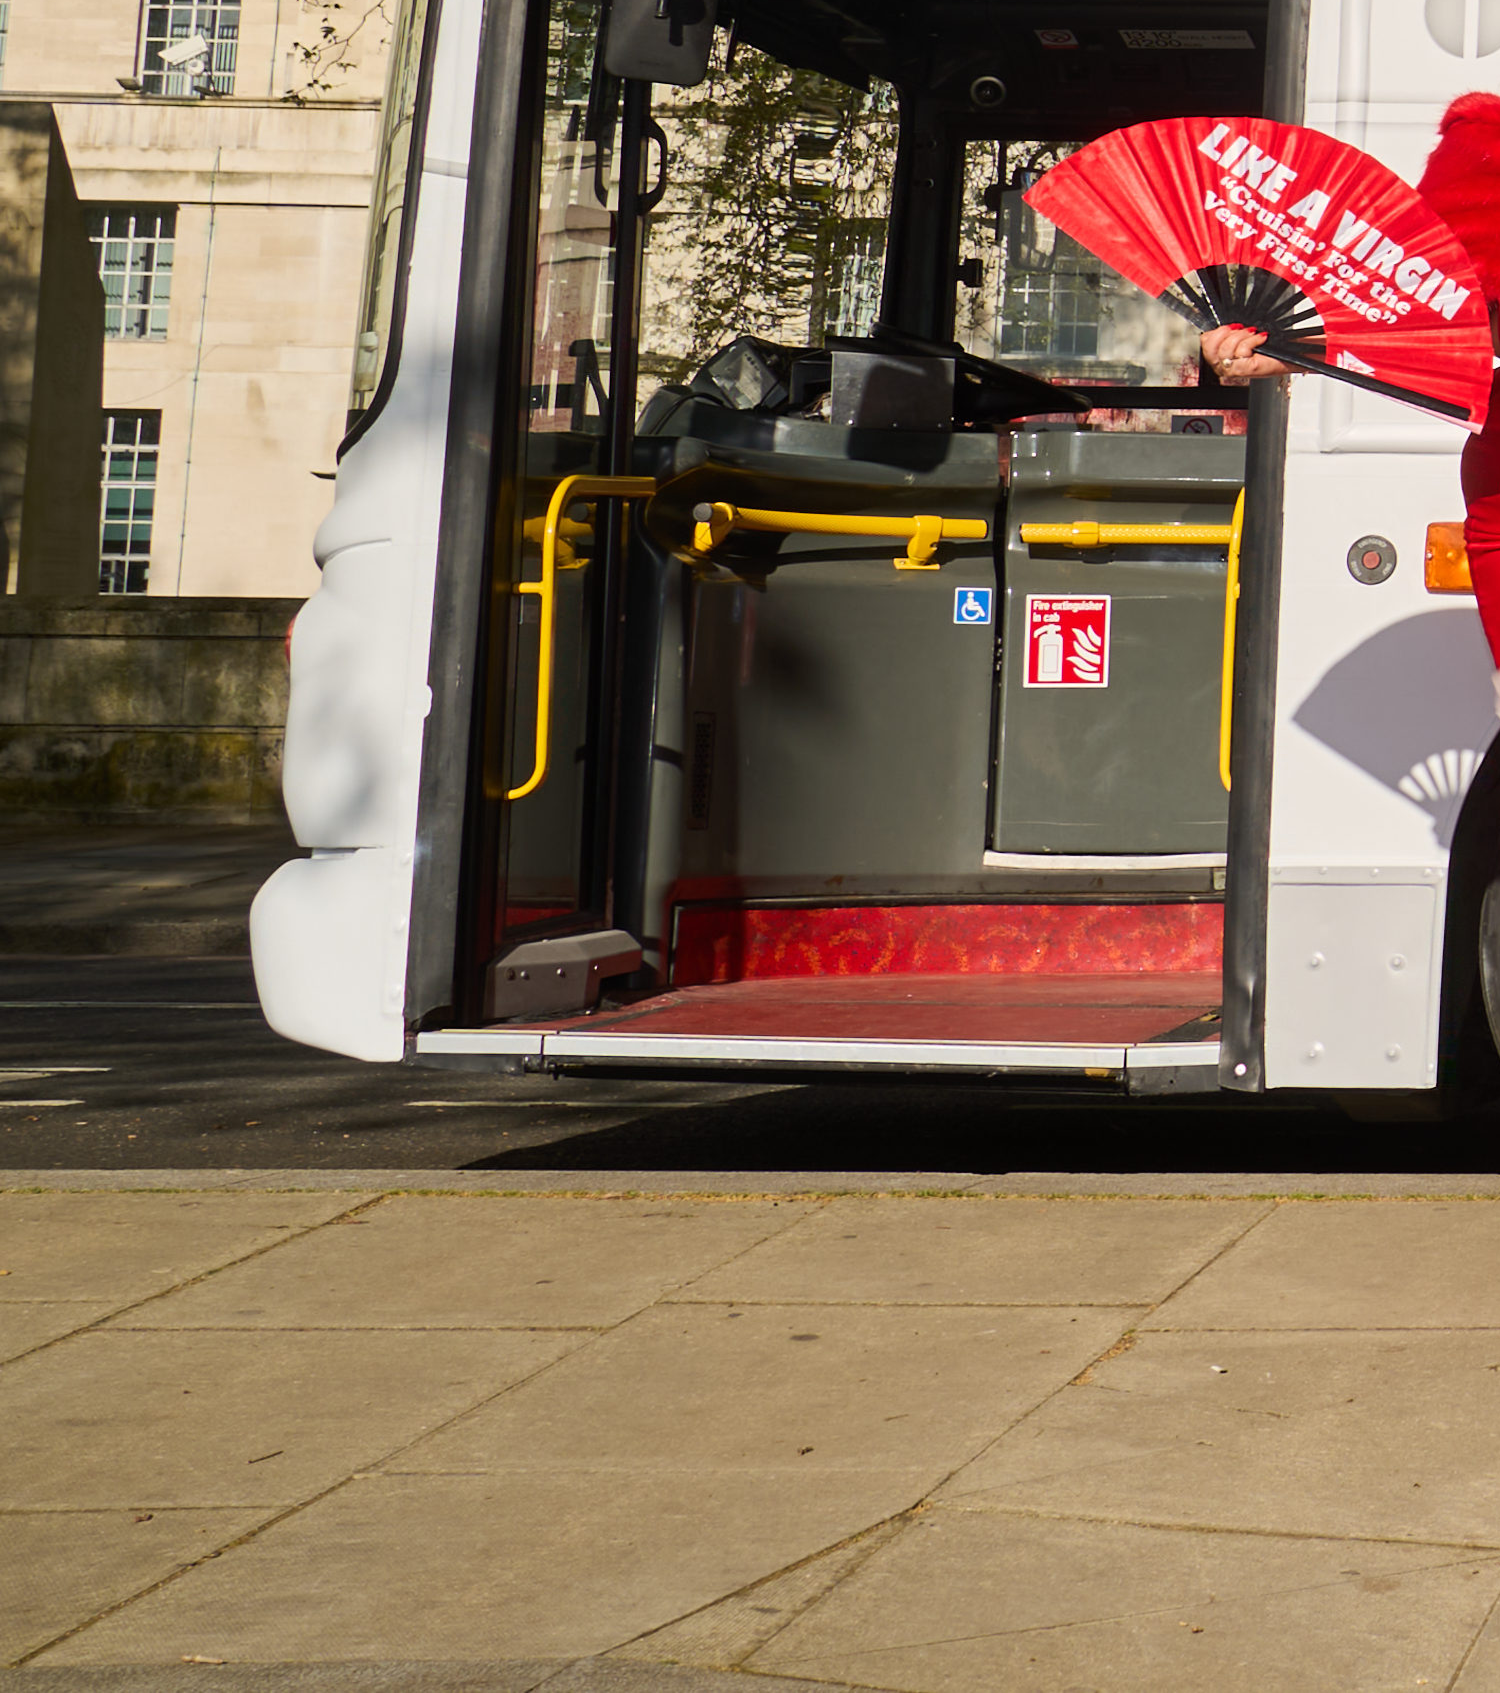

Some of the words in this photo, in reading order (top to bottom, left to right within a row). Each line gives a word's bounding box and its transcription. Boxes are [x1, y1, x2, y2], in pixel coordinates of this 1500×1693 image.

[1198, 123, 1297, 203] LIKE
[1287, 189, 1331, 231] A
[1332, 209, 1471, 321] VIRGIN
[1204, 190, 1258, 240] Very
[1256, 232, 1319, 281] First
[1322, 250, 1369, 286] For
[1369, 281, 1411, 316] the
[1032, 612, 1042, 622] in
[1043, 612, 1060, 622] cab
[1033, 600, 1050, 611] Fire
[1051, 600, 1104, 613] extinguisher
